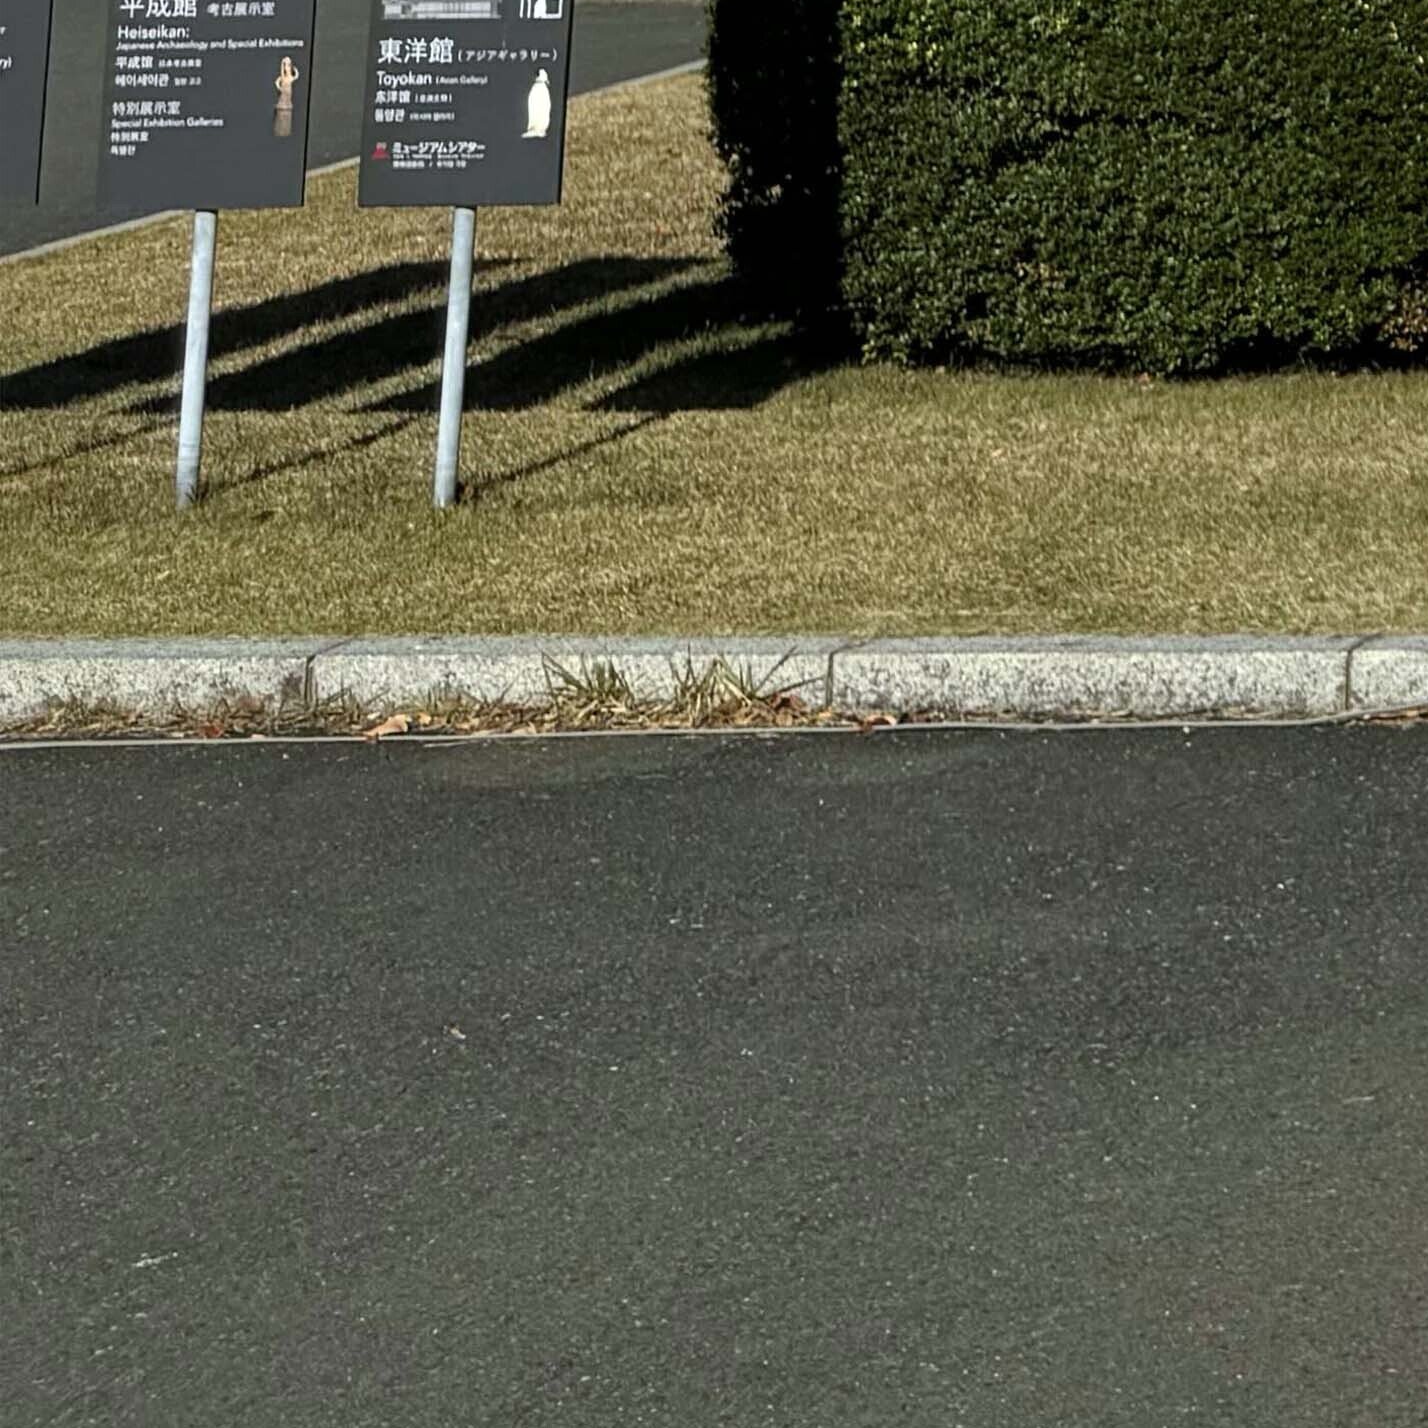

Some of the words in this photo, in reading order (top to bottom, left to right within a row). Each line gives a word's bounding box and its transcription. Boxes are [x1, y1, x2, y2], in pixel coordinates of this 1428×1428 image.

[117, 24, 190, 40] Heiseikan:
[377, 37, 454, 65] 東洋館
[376, 70, 433, 89] Toyokan
